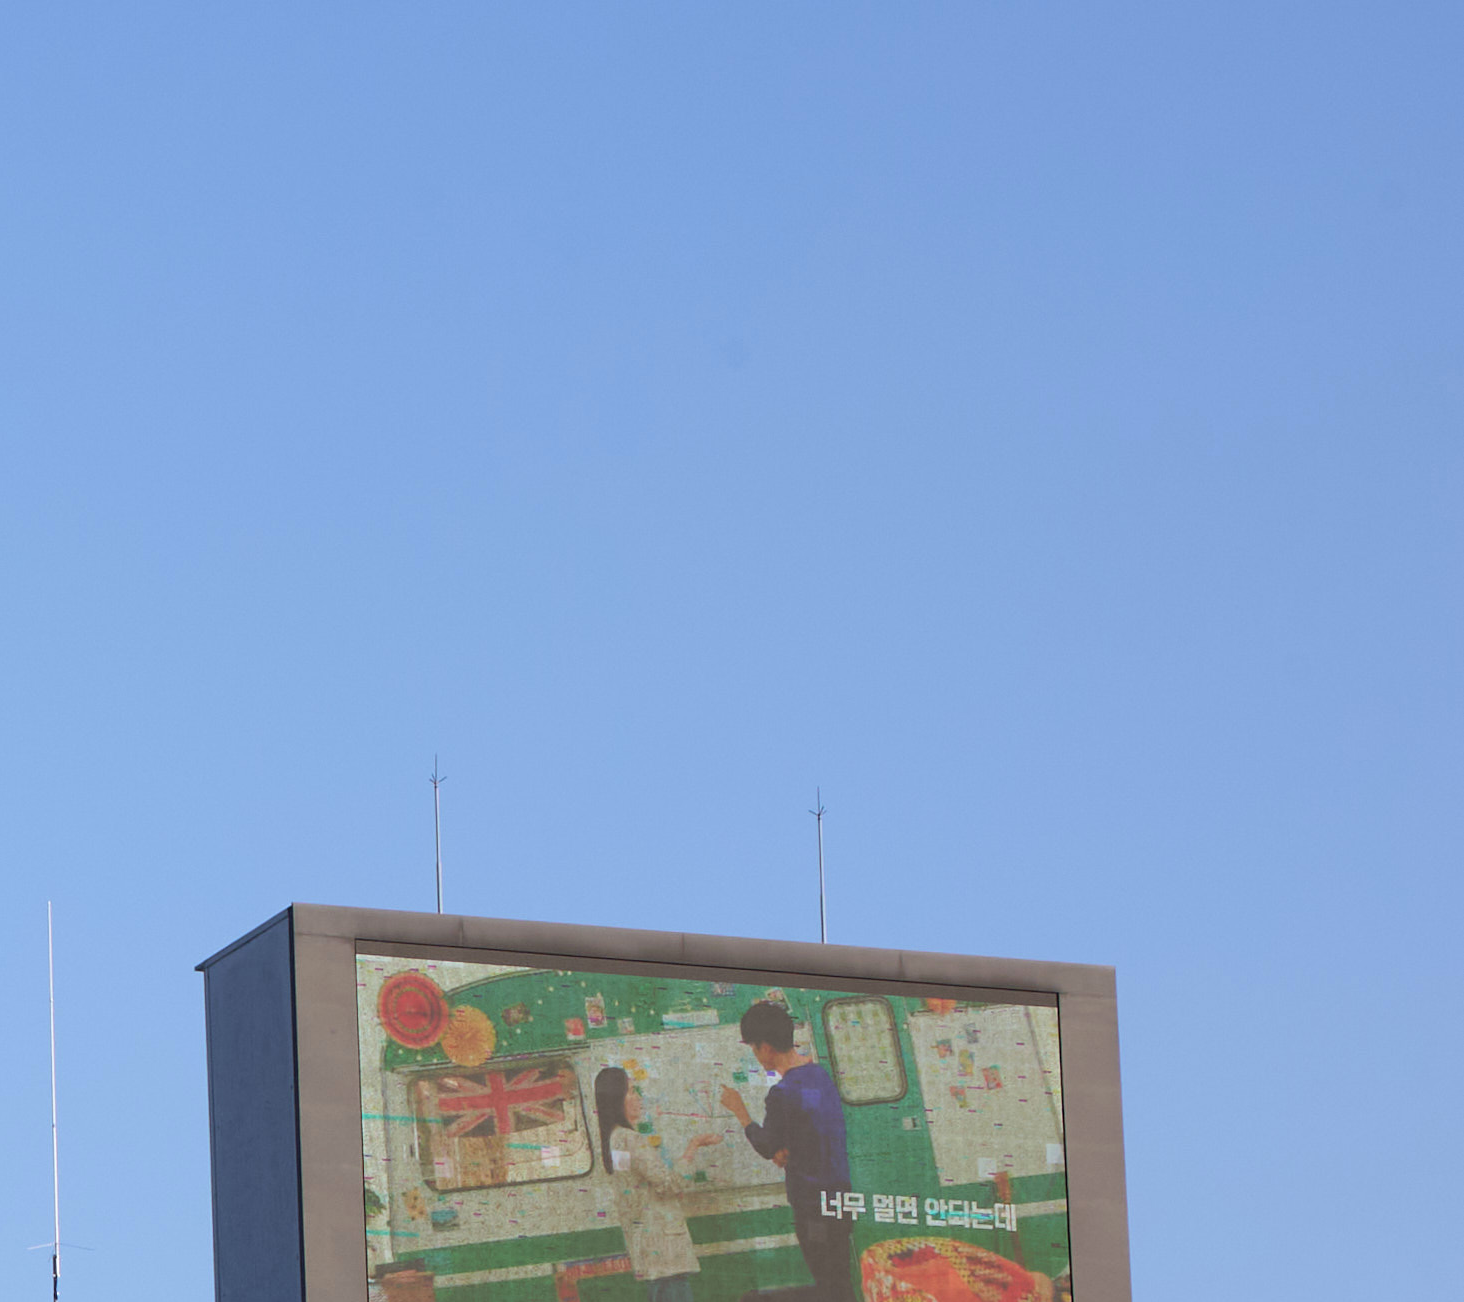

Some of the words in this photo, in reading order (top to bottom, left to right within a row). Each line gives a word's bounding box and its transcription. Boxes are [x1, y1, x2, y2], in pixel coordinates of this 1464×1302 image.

[820, 1190, 866, 1221] 너무
[872, 1194, 919, 1225] 멀면
[924, 1197, 1017, 1231] 안되는데
